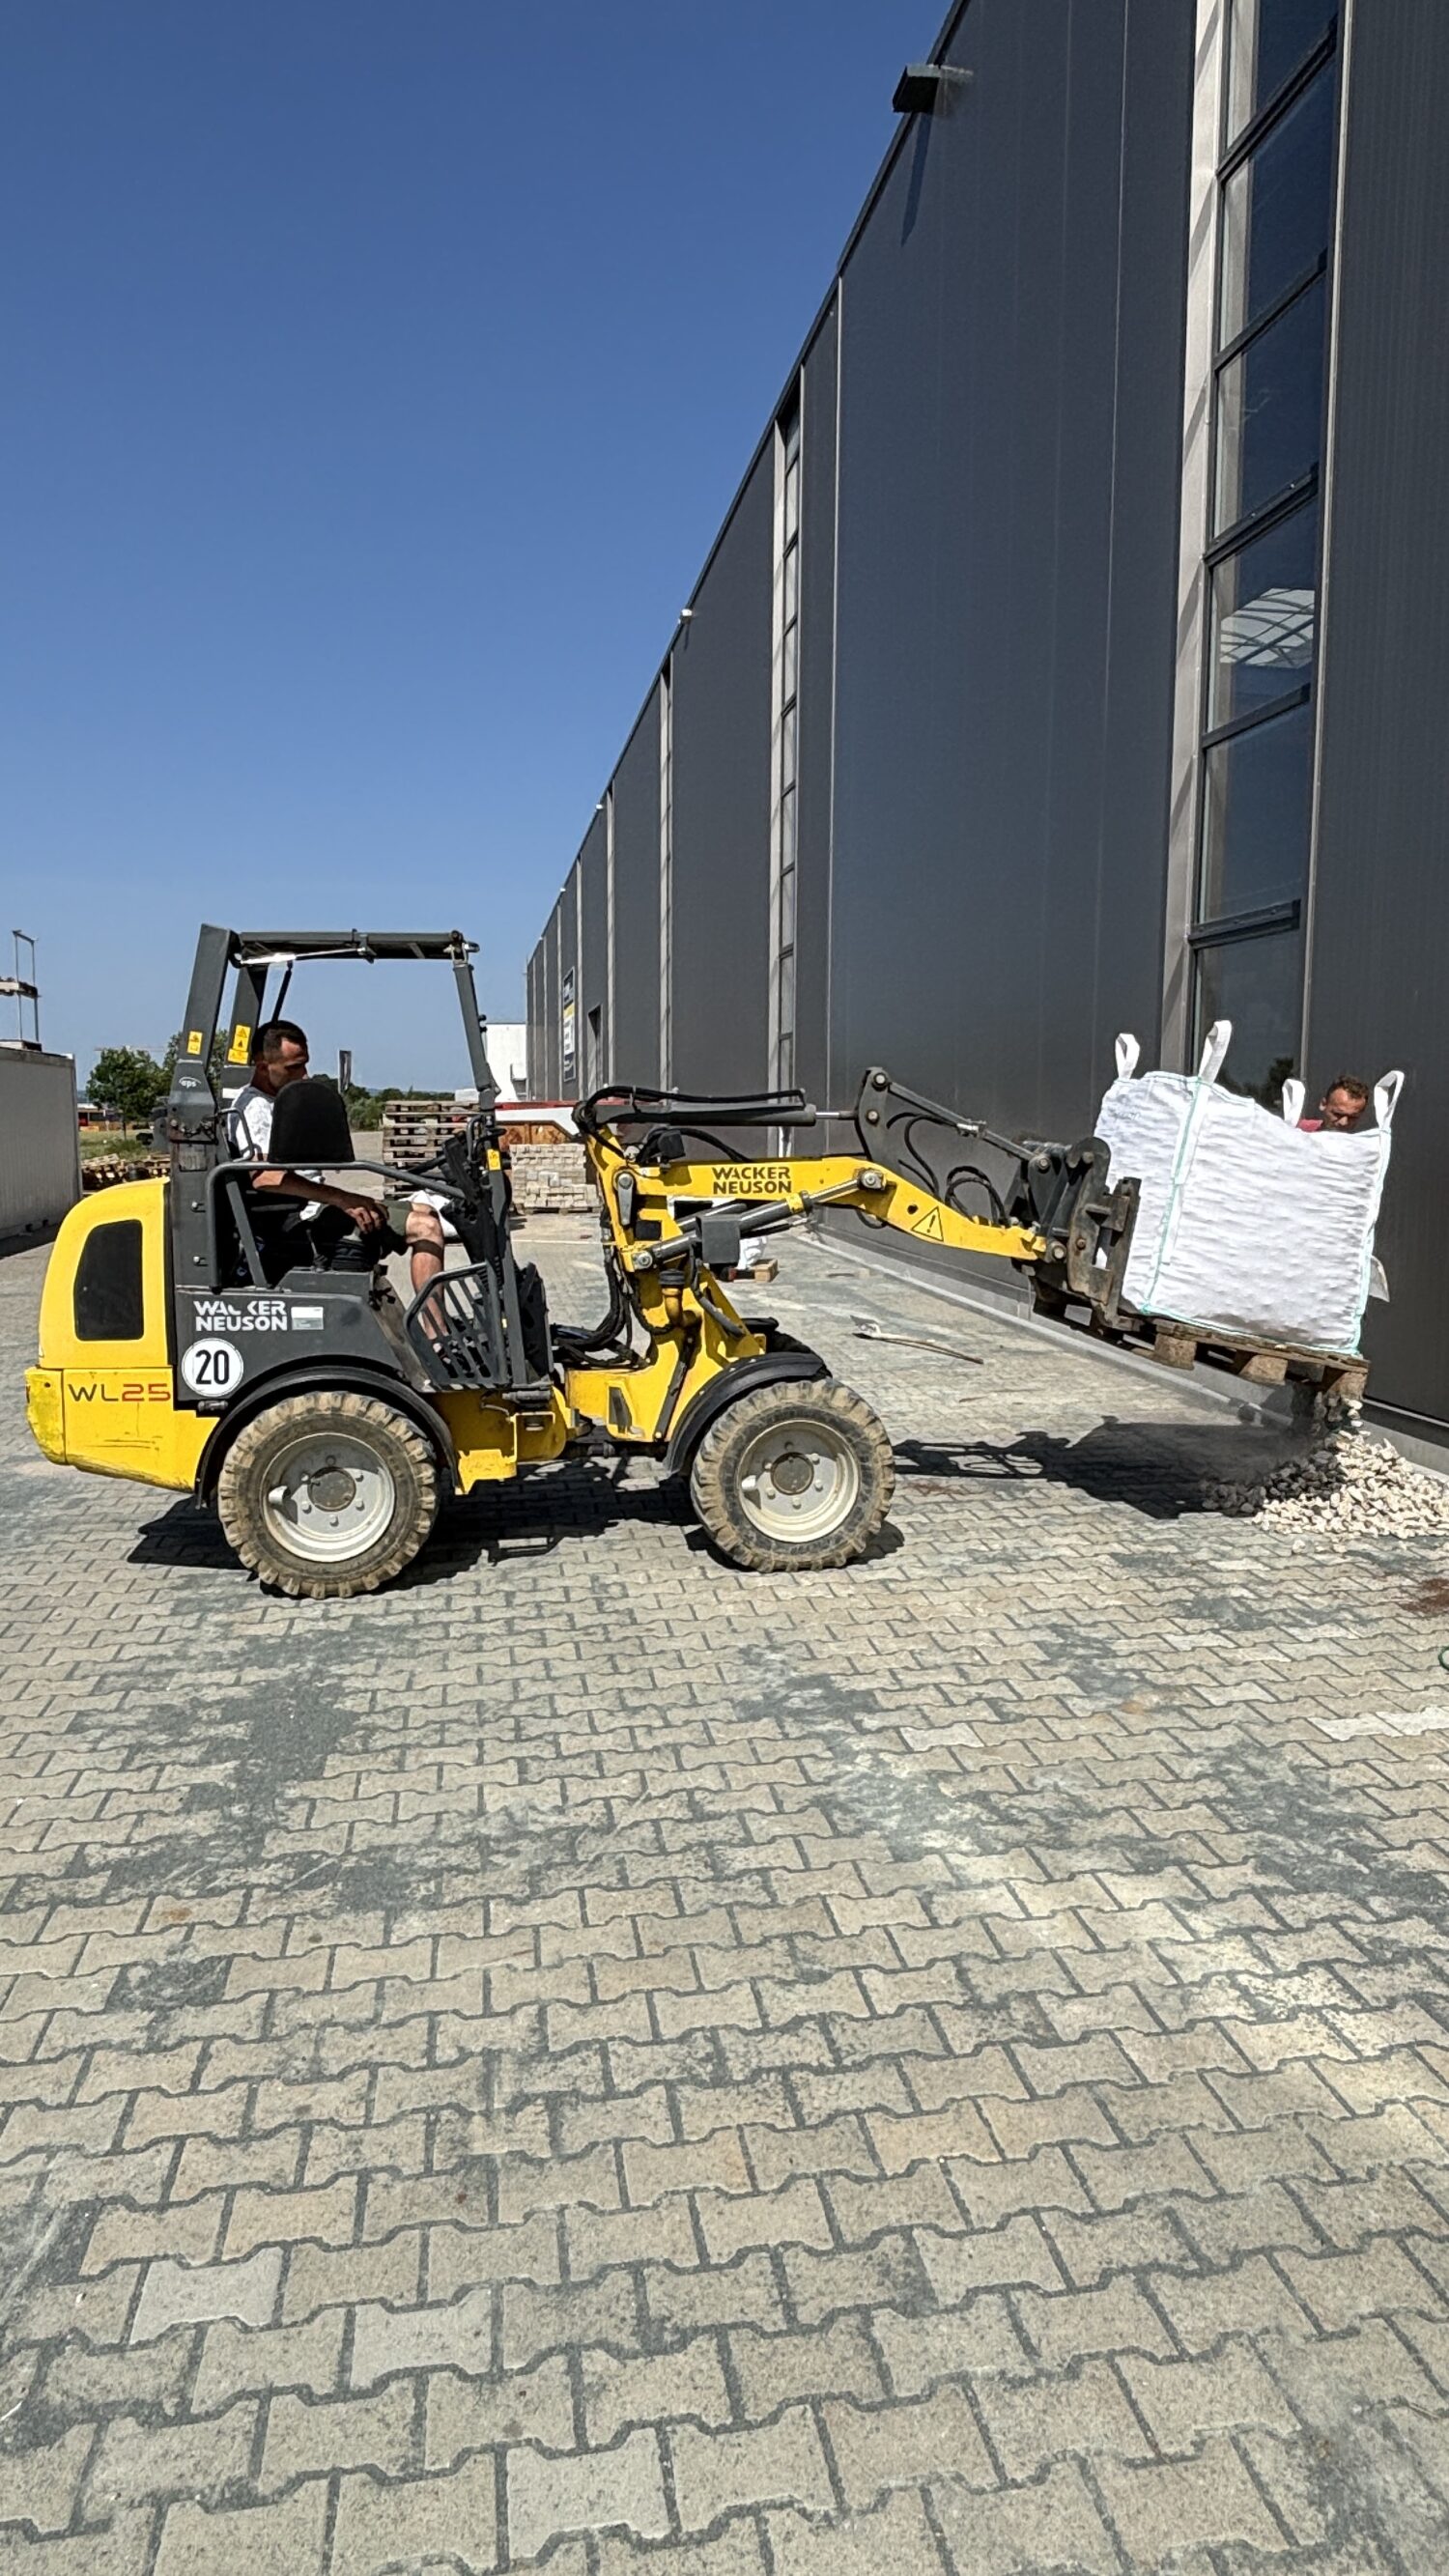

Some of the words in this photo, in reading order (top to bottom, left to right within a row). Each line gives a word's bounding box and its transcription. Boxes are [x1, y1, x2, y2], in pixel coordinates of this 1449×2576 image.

[711, 1167, 791, 1179] WACKER
[713, 1180, 792, 1195] NEUSON
[195, 1316, 288, 1331] NEUSON
[195, 1349, 230, 1385] 20
[68, 1383, 171, 1402] WL25
